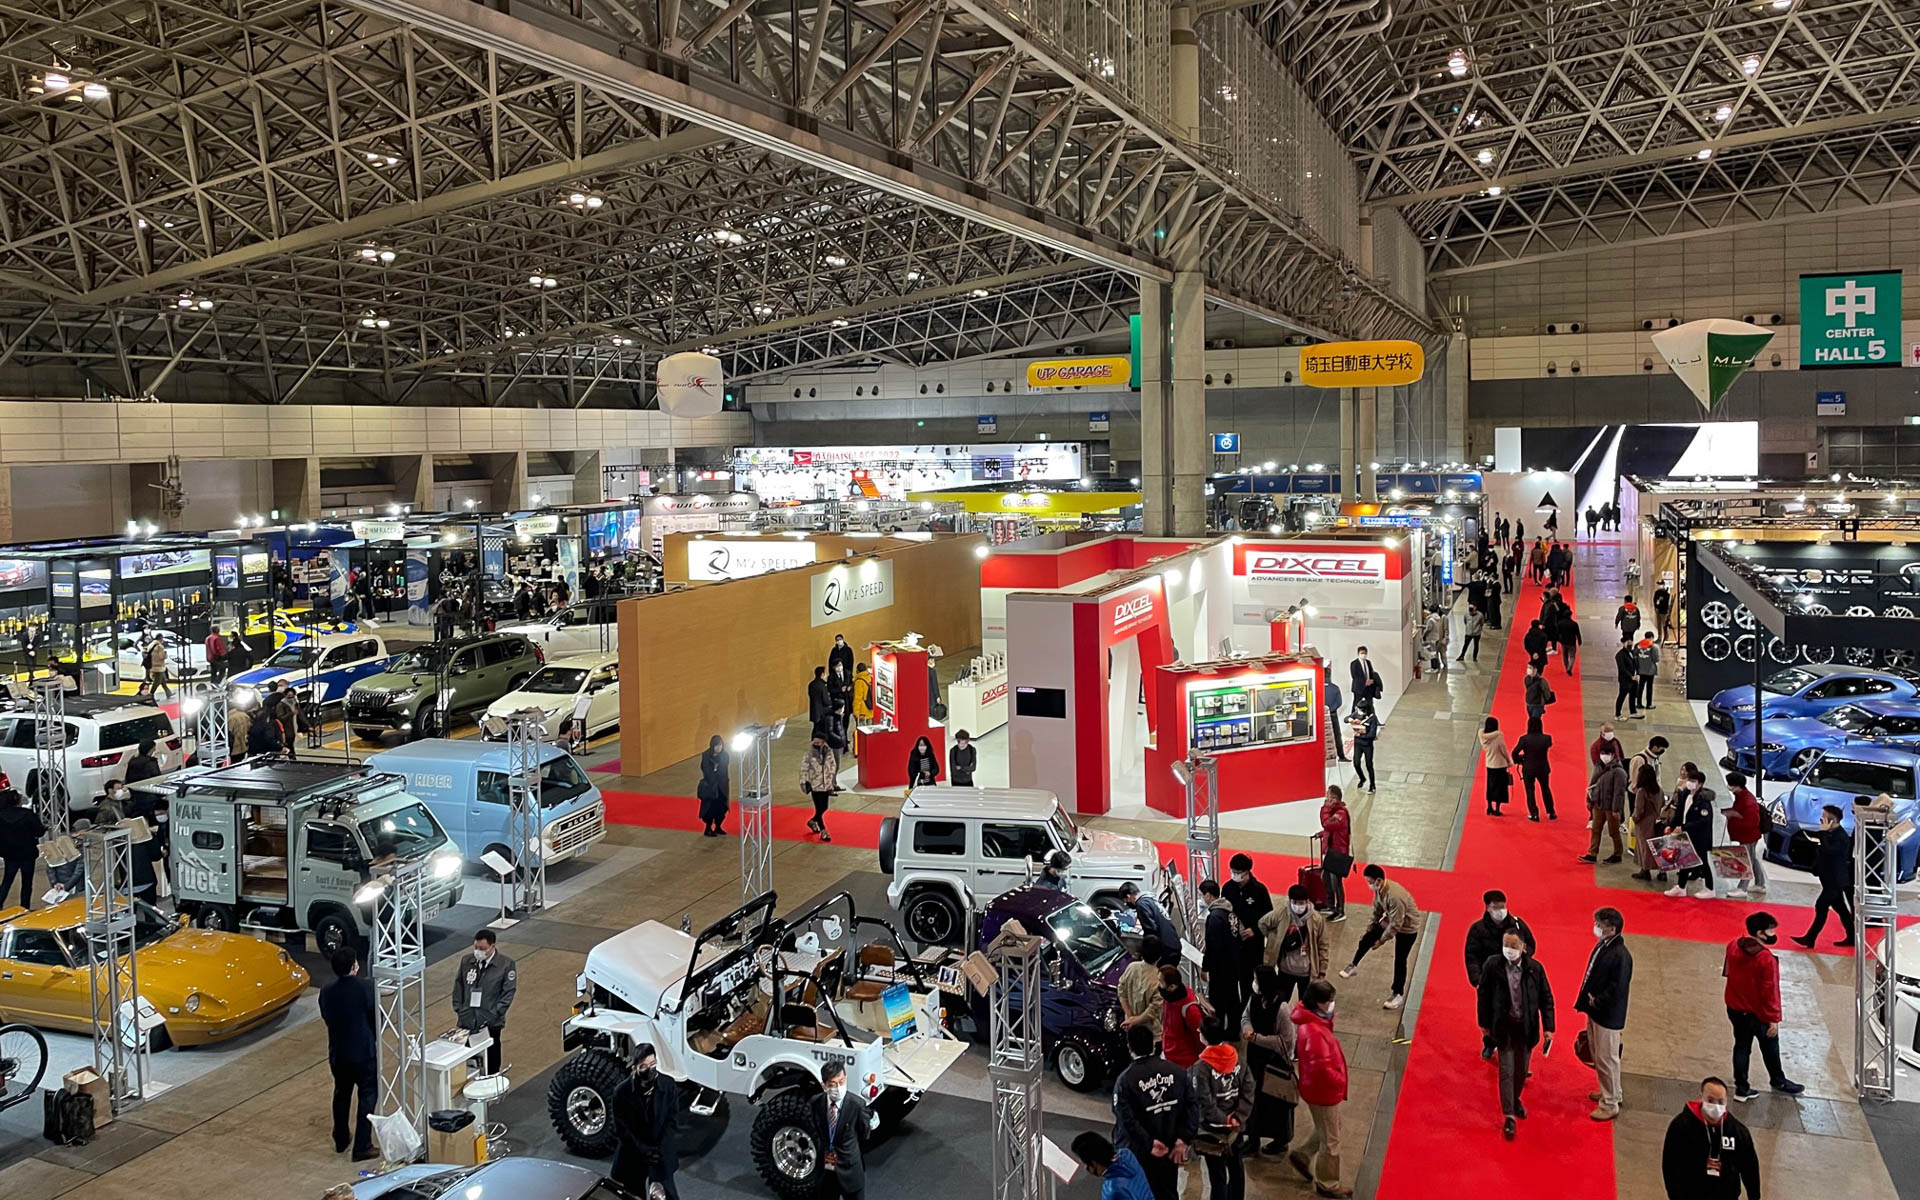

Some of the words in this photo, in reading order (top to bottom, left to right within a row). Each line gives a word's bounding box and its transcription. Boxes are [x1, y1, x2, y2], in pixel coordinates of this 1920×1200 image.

[1825, 280, 1876, 328] 中
[1825, 328, 1875, 338] CENTER
[1815, 347, 1866, 361] HALL
[1867, 339, 1886, 360] 5
[1305, 352, 1414, 373] 埼玉自動車大学校
[1037, 367, 1057, 380] UP
[1058, 364, 1112, 379] GARAGE
[1252, 557, 1379, 577] DIXCEL
[860, 581, 884, 599] SPEED
[1114, 594, 1153, 619] DIXCEL
[982, 682, 1008, 701] DIXCE
[415, 773, 453, 789] RIDER
[175, 803, 202, 820] VAN
[811, 1049, 856, 1067] TURBO
[1138, 1077, 1157, 1093] Body
[1722, 1136, 1735, 1148] D1
